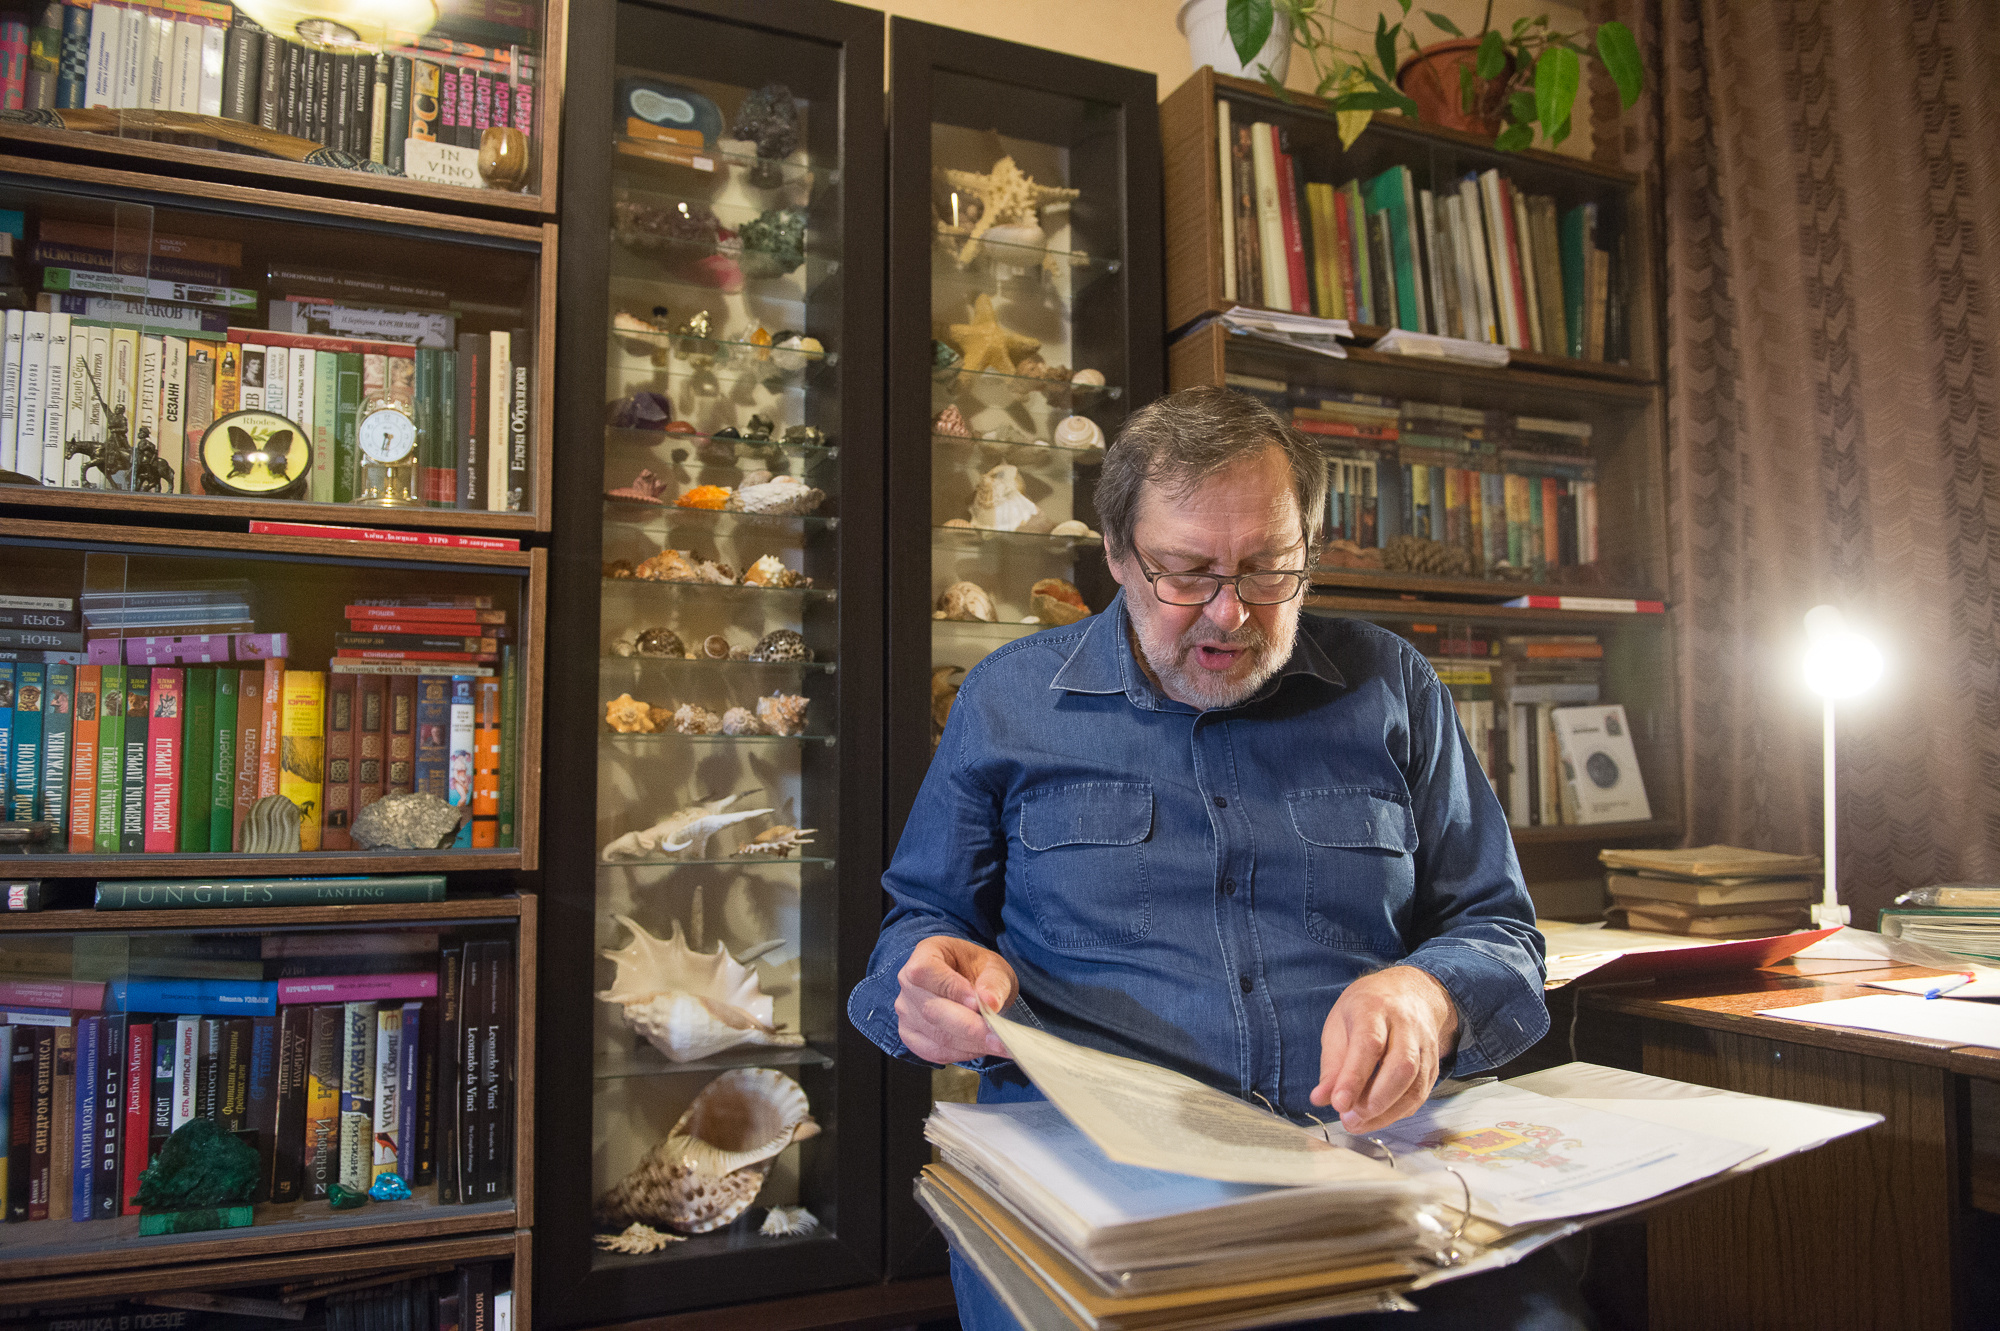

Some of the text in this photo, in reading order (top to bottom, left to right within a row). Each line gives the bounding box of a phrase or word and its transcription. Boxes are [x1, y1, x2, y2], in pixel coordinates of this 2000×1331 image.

[428, 161, 473, 179] VINO
[441, 149, 459, 161] IN
[126, 300, 183, 320] ТАБАКОВ
[2, 362, 19, 419] Шарль Азнавур
[22, 363, 39, 436] Татьяна Тарасова
[45, 365, 63, 448] Владимир Вернадский
[142, 352, 155, 410] РЕНУАРА
[167, 383, 179, 422] СЕЗАНН
[511, 367, 527, 471] Елена Образцова
[23, 614, 66, 626] КЫСЬ
[16, 743, 36, 791] АДАМСОН
[46, 732, 66, 781] ГРЖИМЕК
[215, 729, 233, 784] Даррелл
[239, 728, 258, 784] Даррелл
[73, 742, 93, 837] ДЖЕРАЛЬД ДАРРЕЛЛ
[99, 746, 118, 835] ДЖЕРАЛЬД ДАРРЕЛЛ
[124, 742, 144, 835] ДЖЕРАЛЬД ДАРРЕЛЛ
[152, 738, 173, 833] ДЖЕРАЛЬД ДАРРЕЛЛ
[119, 885, 385, 907] JUNGLES LANTING
[351, 1011, 366, 1046] ДЭН
[488, 1025, 499, 1069] Leonardo
[35, 1038, 51, 1154] СИНДРОМ ФЕНИКСА
[222, 1031, 239, 1115] Фантазии женщины
[235, 1081, 247, 1113] средних
[349, 1048, 365, 1095] БРАУН
[82, 1096, 94, 1131] МОЗГА
[103, 1068, 117, 1170] ЭВЕРЕСТ
[156, 1096, 170, 1127] АБСЕНТ
[381, 1085, 395, 1128] PRADA
[315, 1118, 332, 1179] ИНФЕРНО
